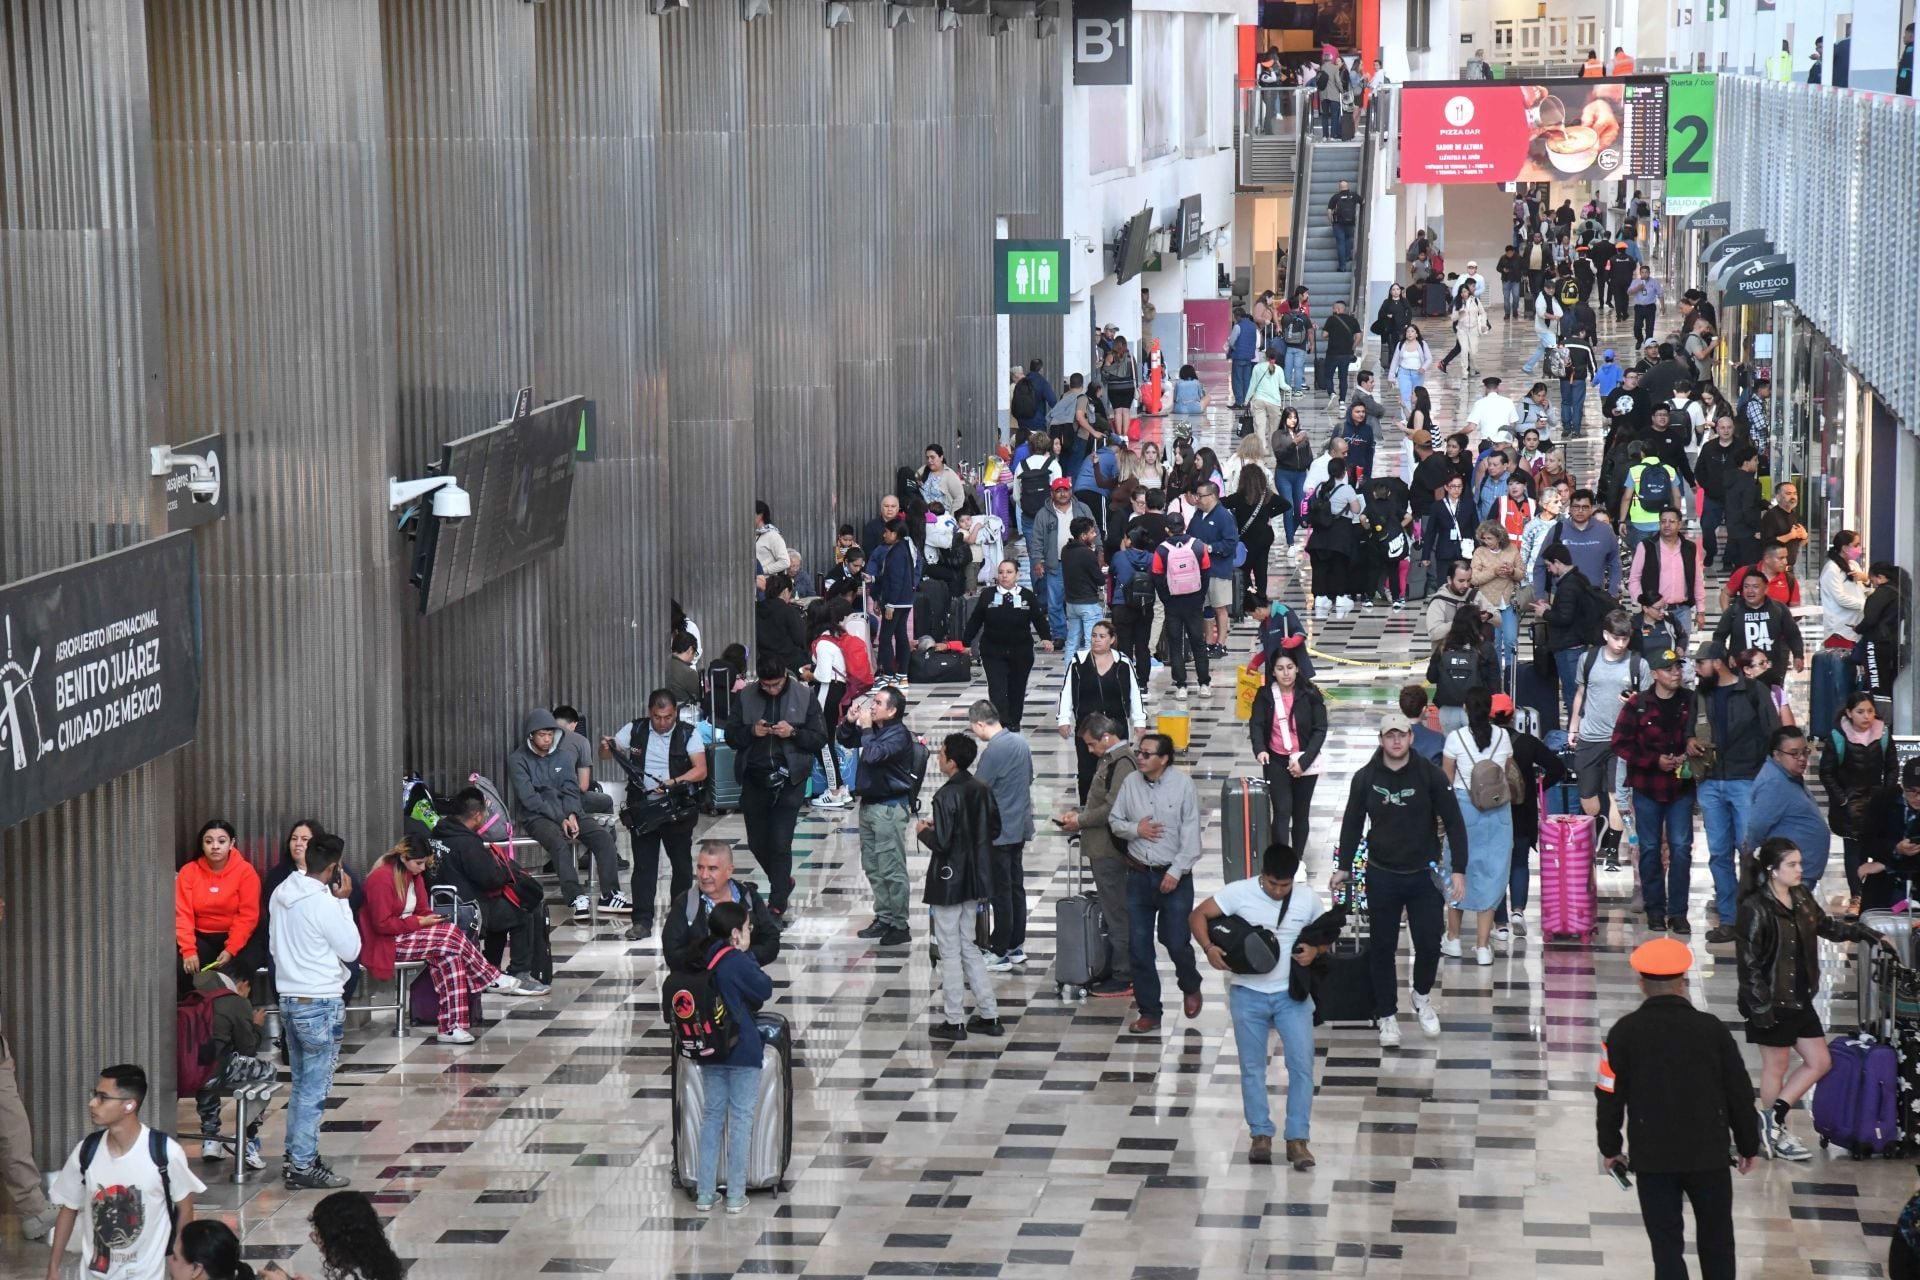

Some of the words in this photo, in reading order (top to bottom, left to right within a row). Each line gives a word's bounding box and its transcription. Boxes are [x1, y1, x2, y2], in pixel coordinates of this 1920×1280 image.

[1672, 115, 1709, 174] 2
[1667, 199, 1698, 207] SALIDA
[1739, 277, 1789, 291] PROFECO
[1744, 613, 1759, 621] FELIZ
[56, 628, 106, 663] AEROPUERTO
[106, 609, 159, 644] INTERNACIONAL
[56, 659, 109, 711] BENITO
[111, 638, 161, 689] JUÁREZ
[1869, 670, 1880, 688] PINK
[58, 708, 102, 752] CIUDAD
[104, 700, 120, 732] DE
[121, 683, 162, 724] MÉXICO
